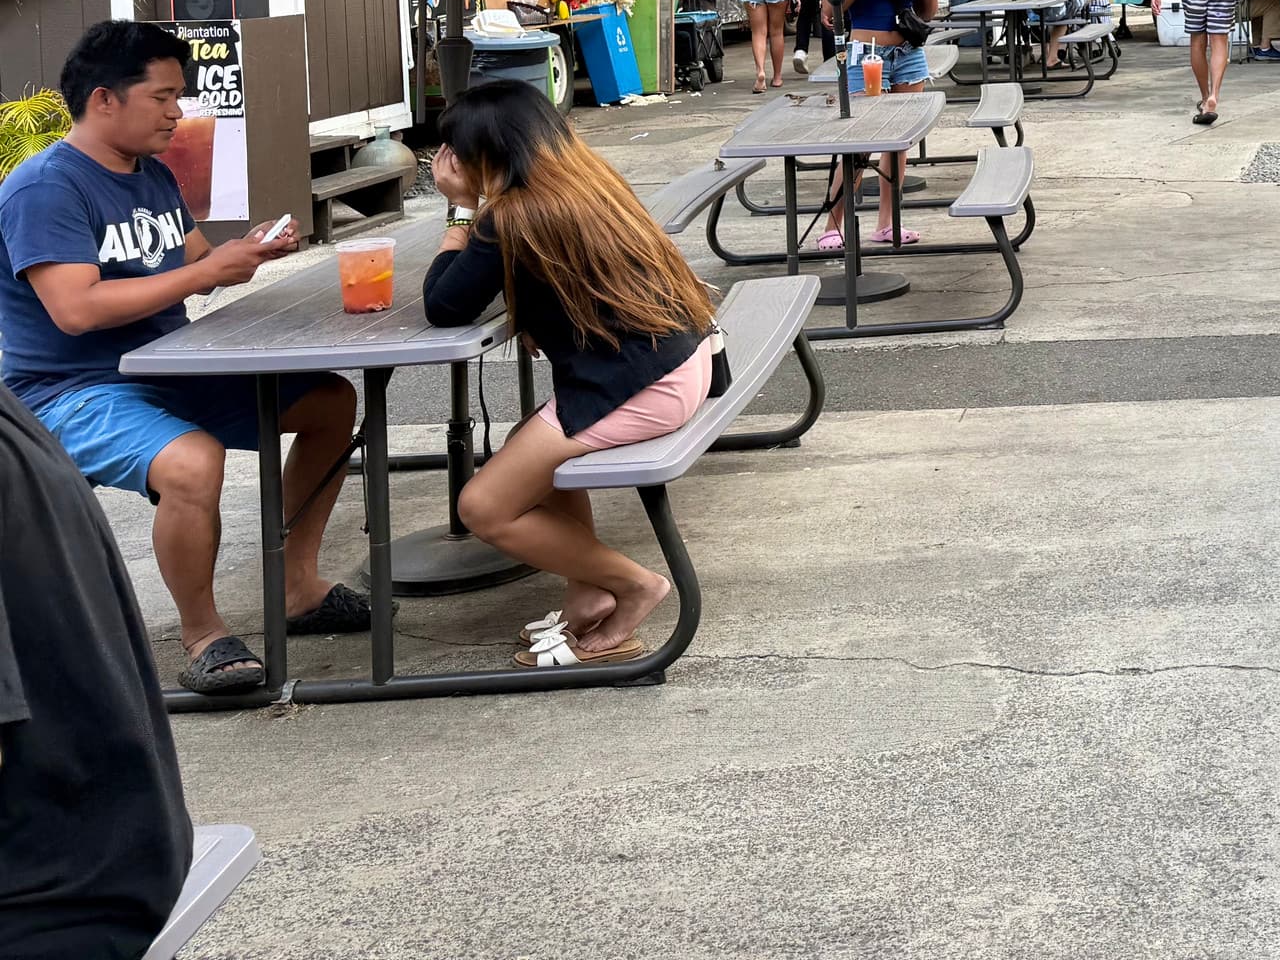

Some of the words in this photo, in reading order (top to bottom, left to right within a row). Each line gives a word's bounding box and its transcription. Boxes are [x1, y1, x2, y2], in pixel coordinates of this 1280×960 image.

[177, 26, 230, 38] Plantation
[188, 39, 230, 61] Tea
[197, 64, 240, 90] ICE
[198, 90, 242, 107] COLD
